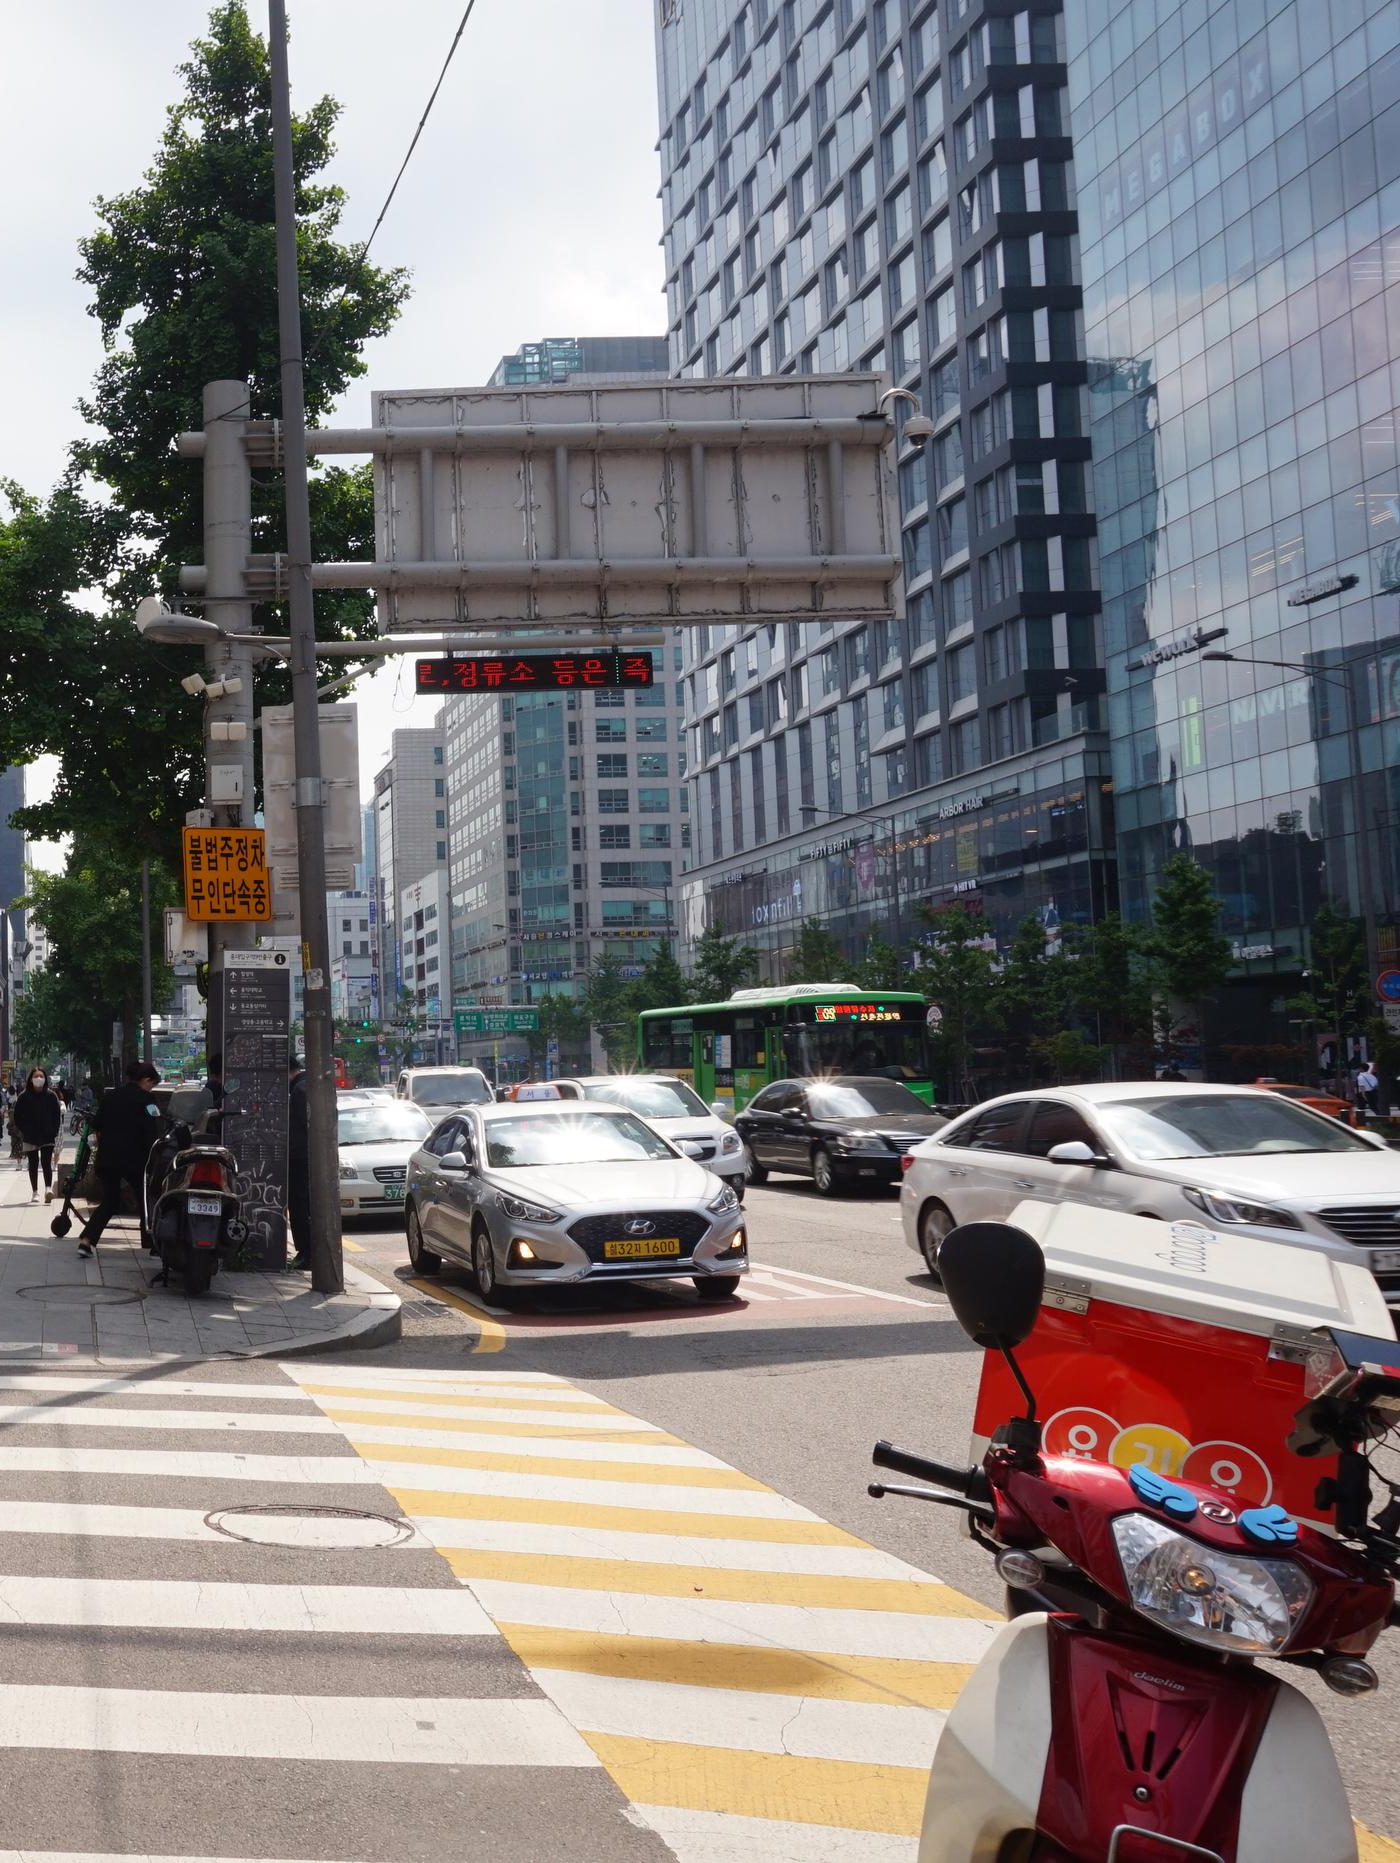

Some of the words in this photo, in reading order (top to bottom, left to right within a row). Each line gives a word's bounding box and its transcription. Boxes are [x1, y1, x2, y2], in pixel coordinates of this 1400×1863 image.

[1104, 62, 1265, 221] MEGABOX
[551, 658, 609, 685] 등은
[939, 801, 964, 820] ARBOR
[965, 796, 984, 813] HAIR
[188, 835, 265, 872] 불법주정차
[191, 878, 266, 915] 무인단속중
[197, 1204, 219, 1213] 3349
[643, 1241, 675, 1254] 1600
[1133, 1671, 1185, 1692] daelim
